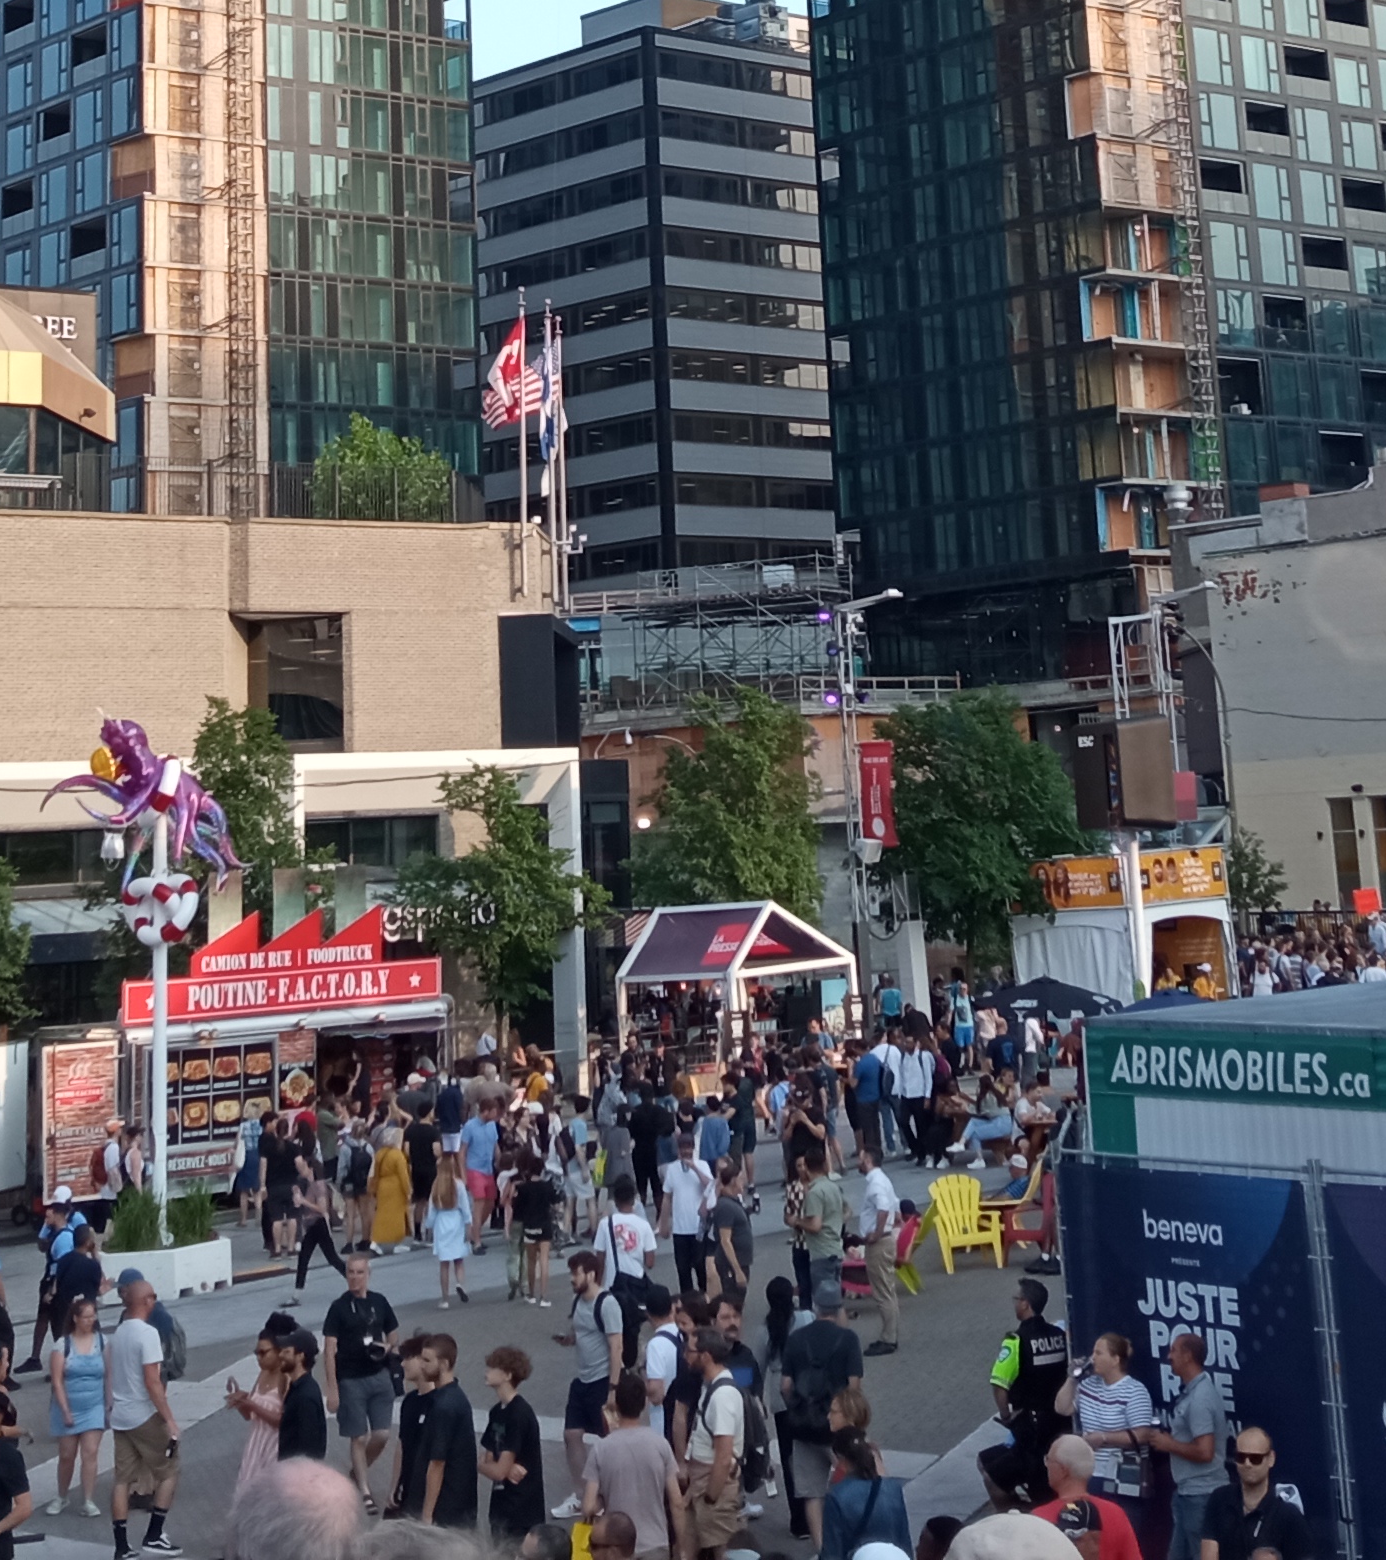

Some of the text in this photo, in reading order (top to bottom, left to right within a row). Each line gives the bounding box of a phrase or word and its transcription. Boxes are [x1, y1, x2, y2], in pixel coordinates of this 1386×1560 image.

[1077, 735, 1094, 748] ESC
[201, 953, 247, 973] CAMION
[250, 951, 265, 969] DE
[268, 949, 292, 968] RUE
[307, 944, 373, 965] FOODTRUCK
[1111, 1043, 1371, 1098] ABRISMOBILES.ca
[1142, 1208, 1223, 1246] beneva
[1137, 1277, 1241, 1327] JUSTE
[1159, 1363, 1235, 1413] RE
